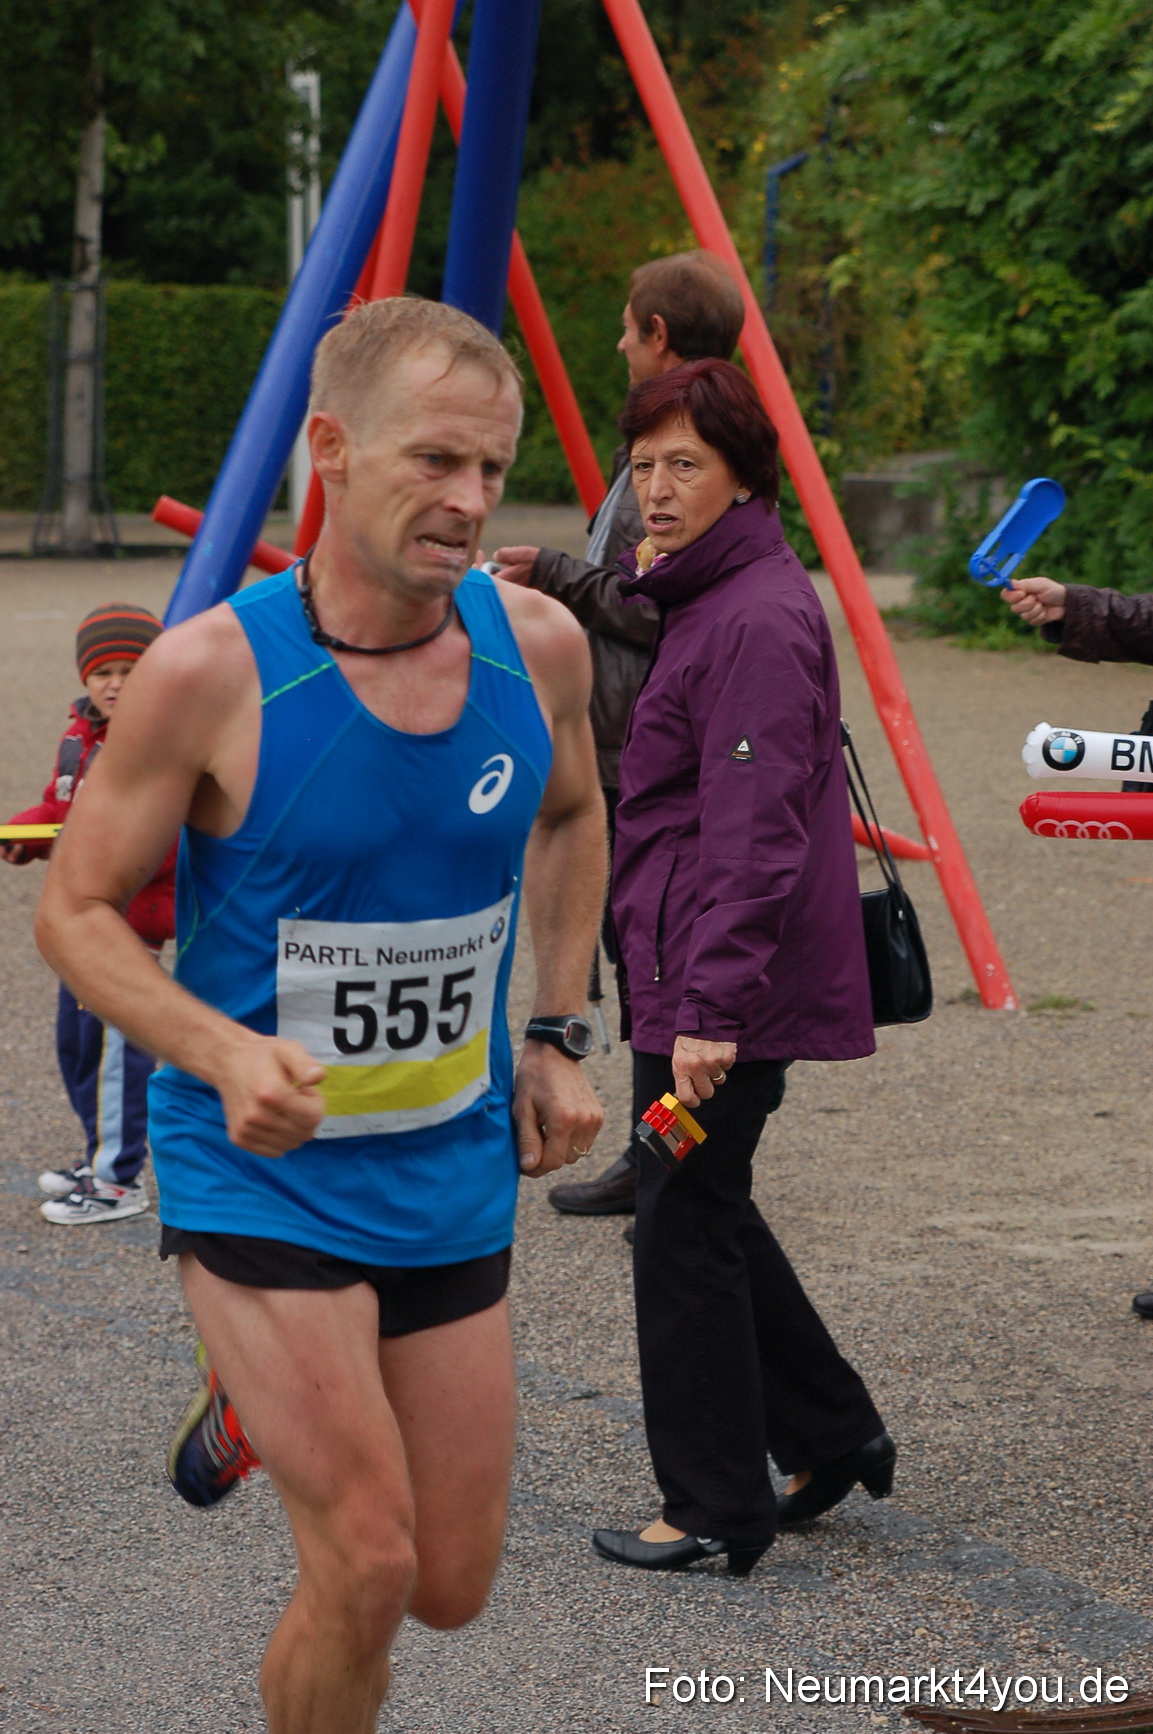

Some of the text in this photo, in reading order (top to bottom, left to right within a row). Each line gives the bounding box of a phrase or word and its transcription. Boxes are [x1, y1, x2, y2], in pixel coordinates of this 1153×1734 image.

[284, 934, 484, 967] PARTL Neumarkt
[332, 966, 476, 1055] 555
